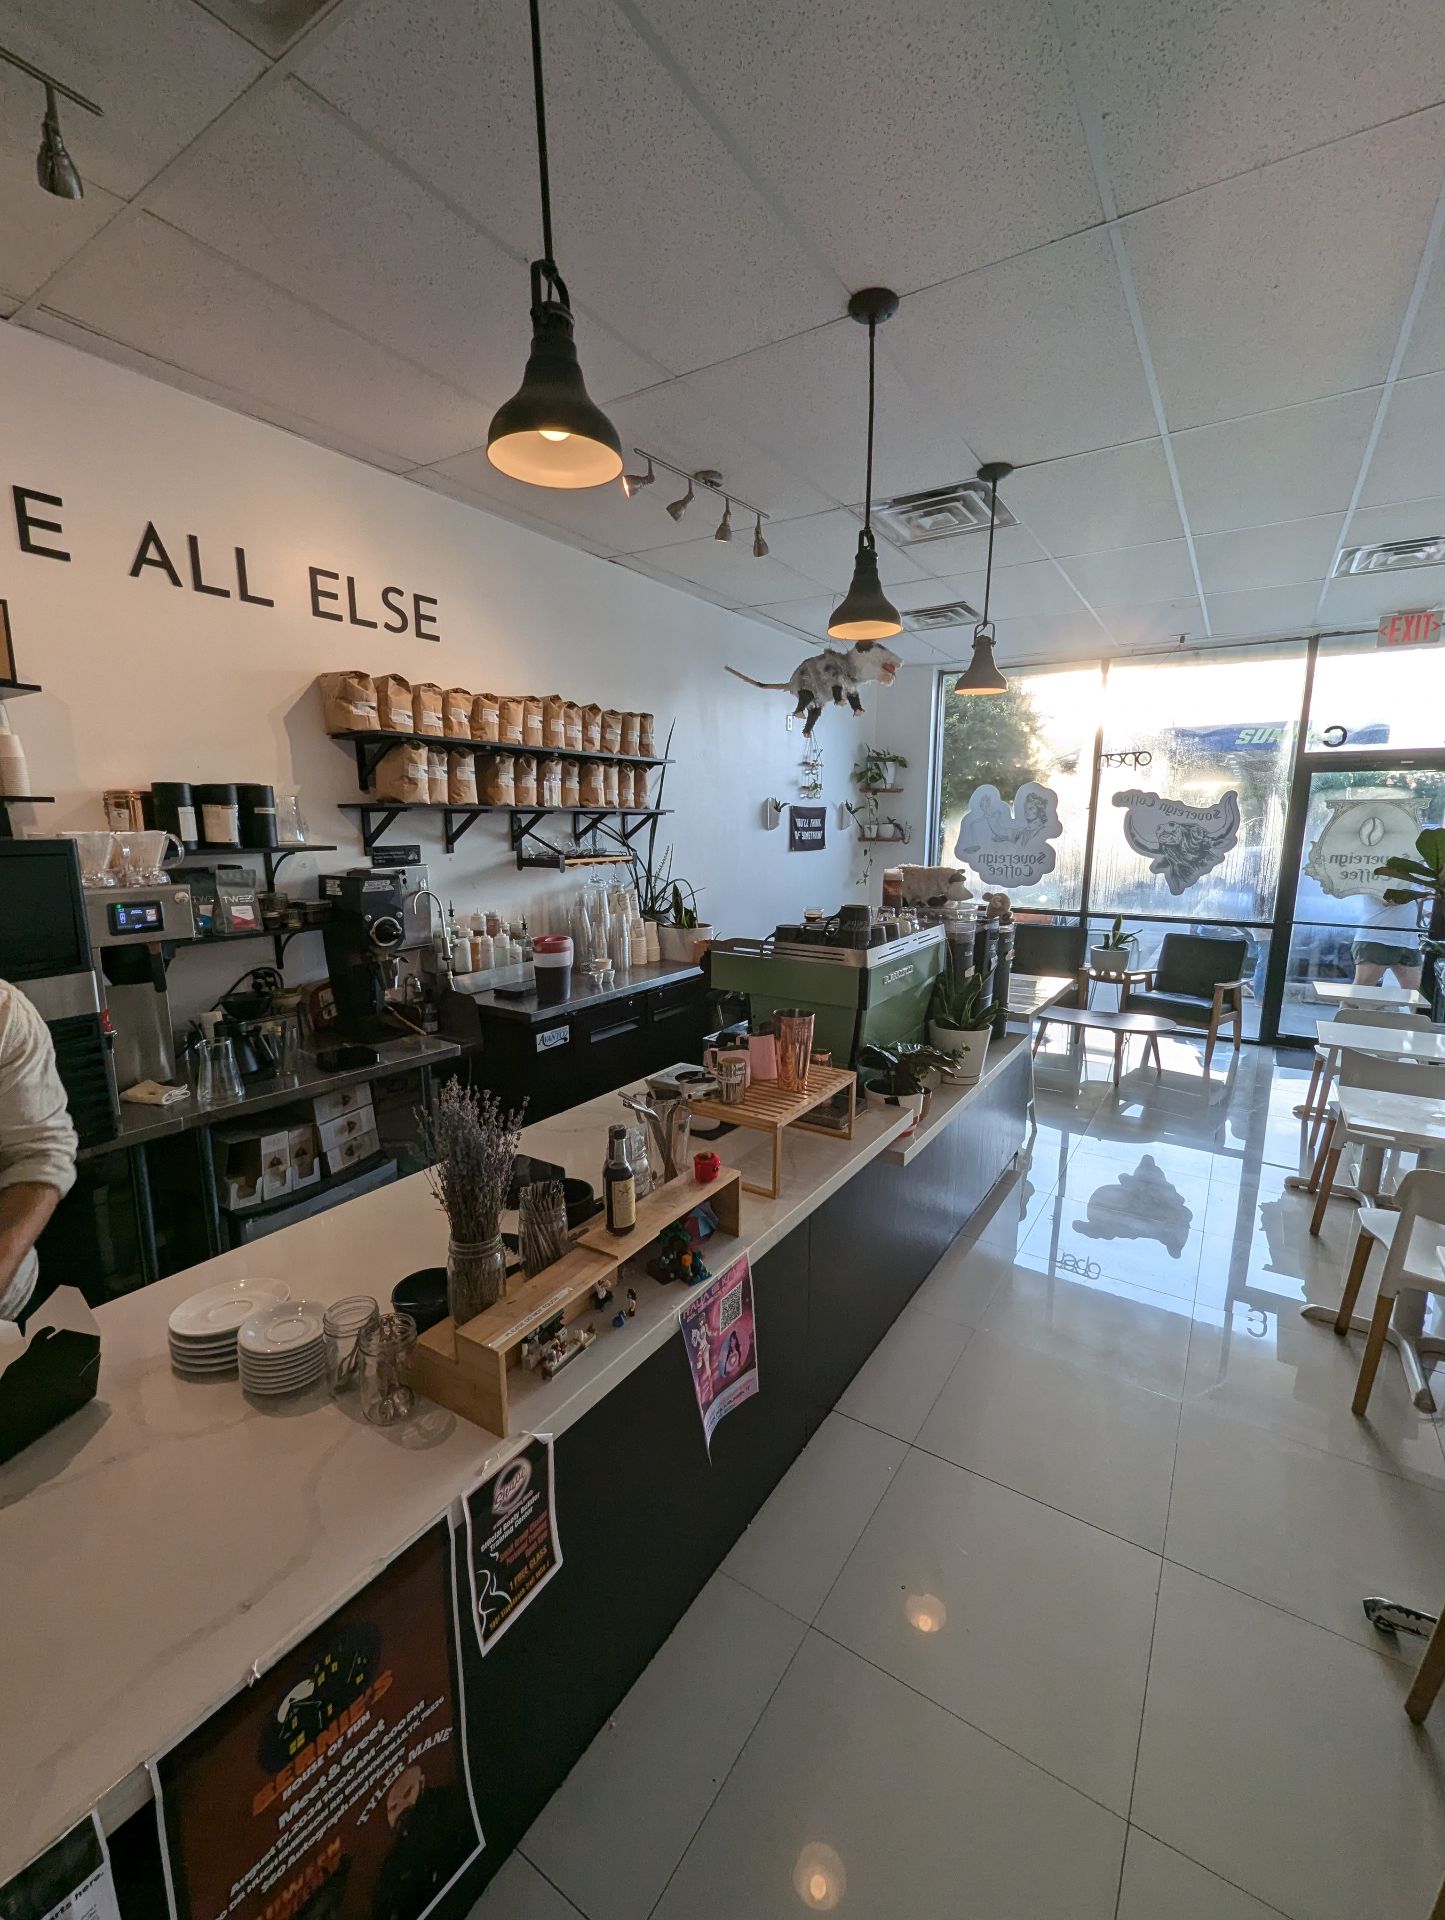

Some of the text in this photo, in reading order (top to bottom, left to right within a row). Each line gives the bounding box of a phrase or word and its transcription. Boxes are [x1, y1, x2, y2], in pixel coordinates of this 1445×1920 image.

[129, 521, 275, 607] ALL
[308, 566, 441, 642] ELSE
[1388, 612, 1435, 643] EXIT
[530, 1545, 547, 1569] CLASS
[251, 1671, 393, 1817] BERNIE'S
[279, 1776, 327, 1830] Meet
[328, 1764, 340, 1781] &
[342, 1719, 384, 1766] Greet
[283, 1711, 370, 1801] HOUSE OF FUN
[356, 1728, 452, 1826] TYLER MANE
[231, 1846, 276, 1896] August
[287, 1804, 348, 1868] Autograph
